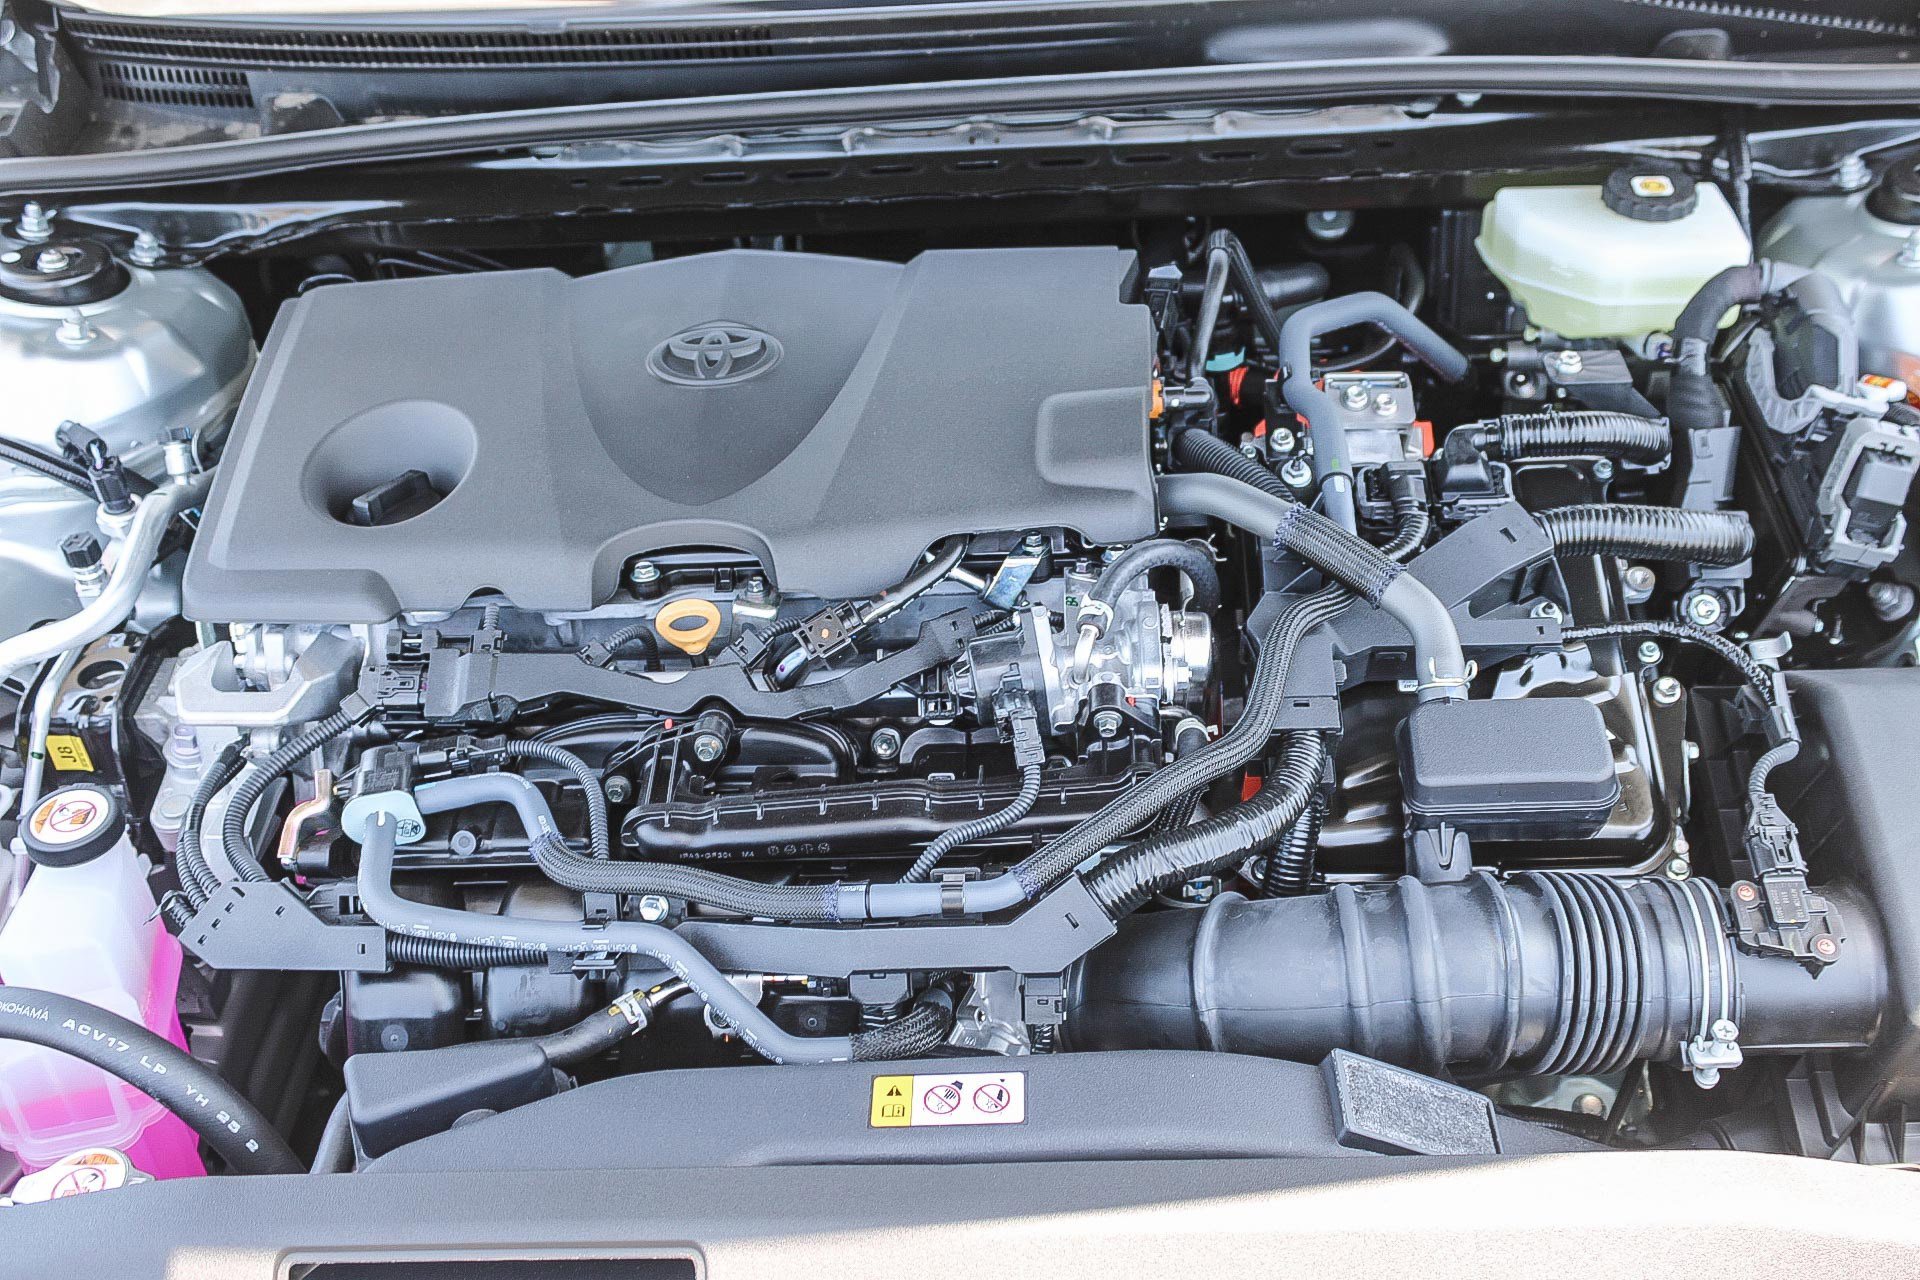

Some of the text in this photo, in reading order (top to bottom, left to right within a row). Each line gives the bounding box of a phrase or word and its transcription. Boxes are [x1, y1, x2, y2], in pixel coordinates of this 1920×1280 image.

[0, 1001, 49, 1022] KOHAMA
[140, 1055, 167, 1075] LP
[186, 1084, 210, 1108] YH
